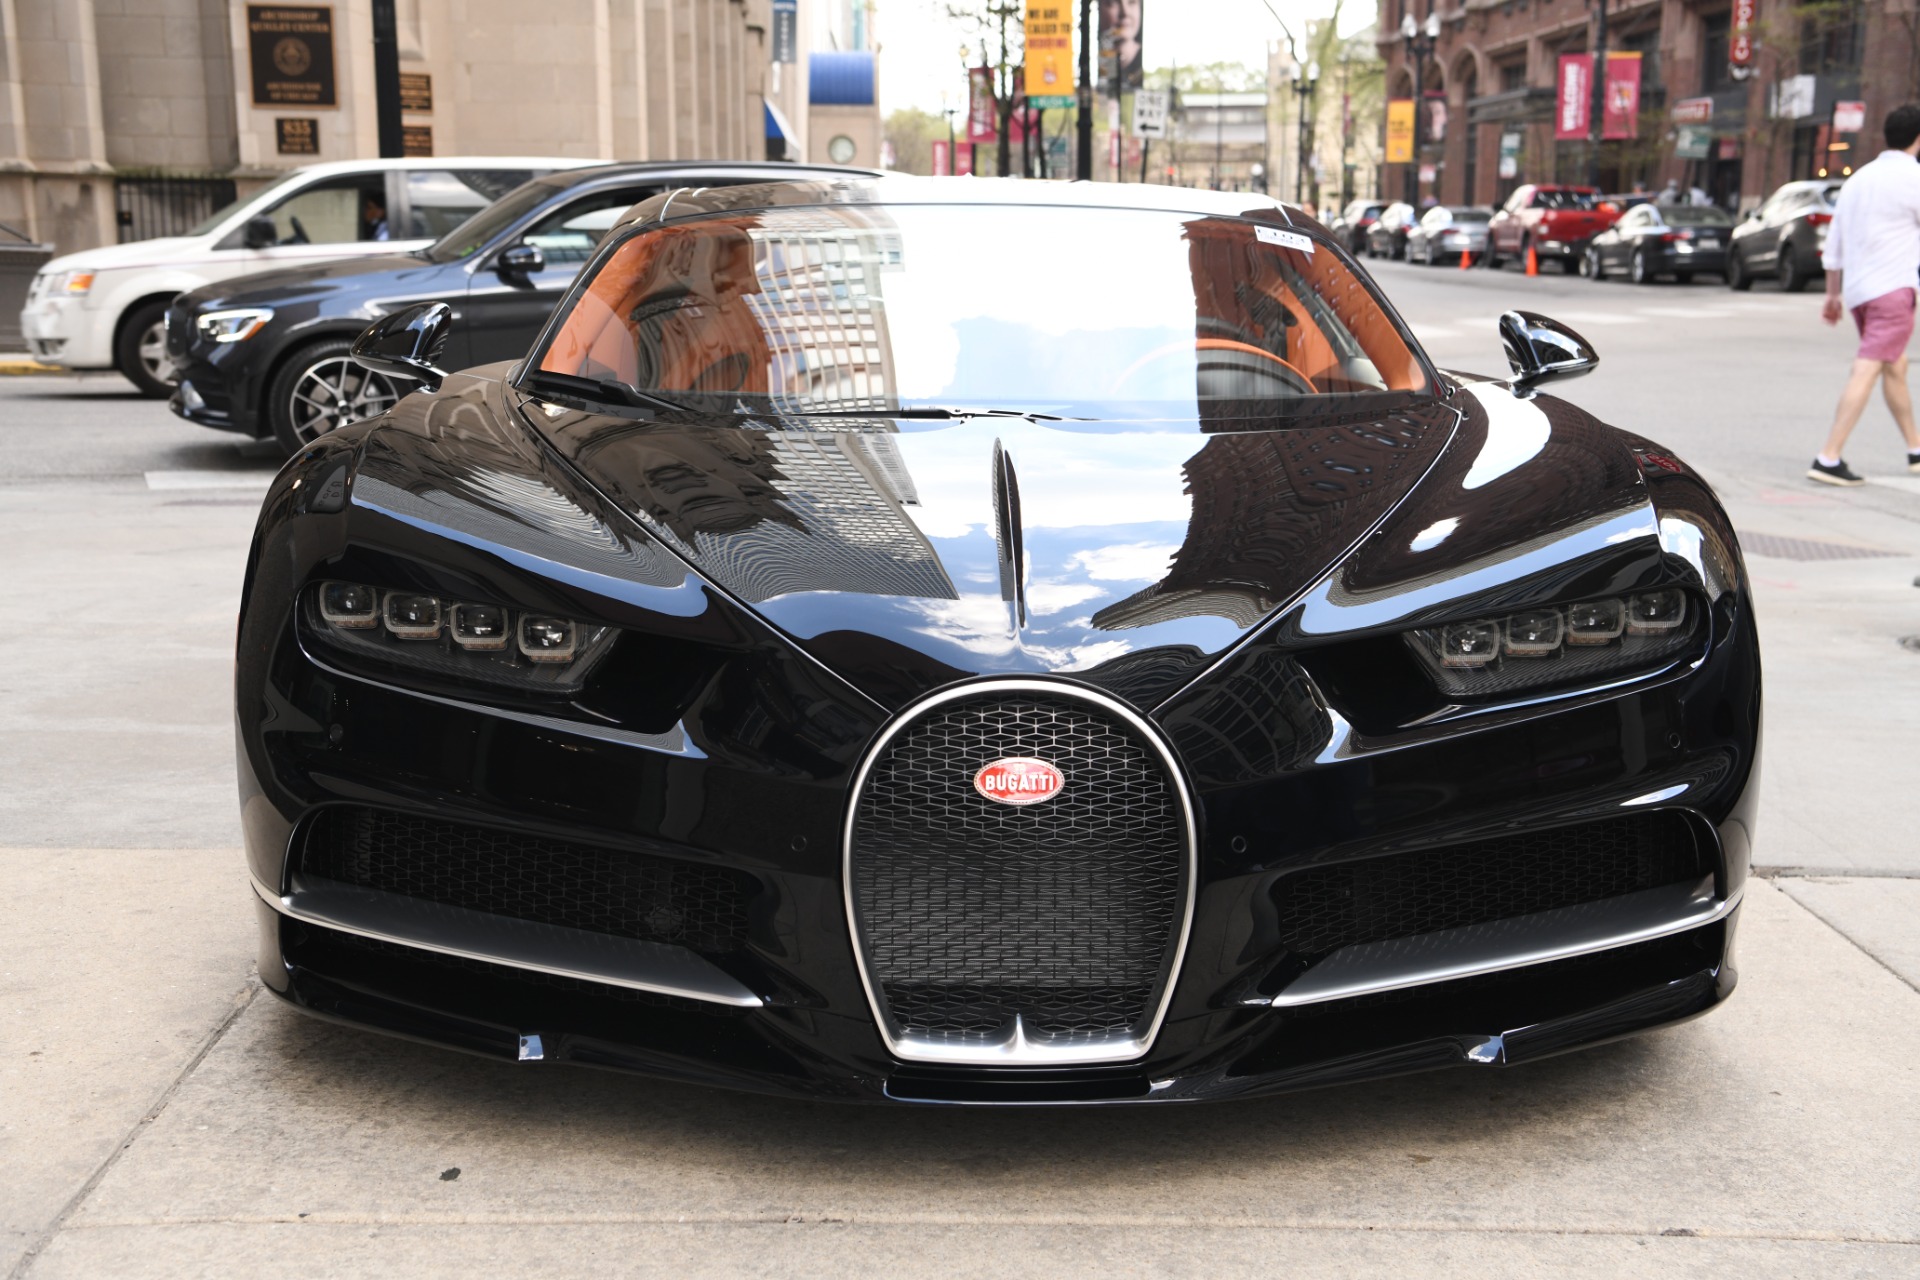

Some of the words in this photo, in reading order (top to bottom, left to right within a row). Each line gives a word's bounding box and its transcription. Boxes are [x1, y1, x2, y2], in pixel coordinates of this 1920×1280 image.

[1138, 93, 1164, 106] ONE
[1137, 109, 1163, 118] WAY
[985, 774, 1054, 791] BUGATTI
